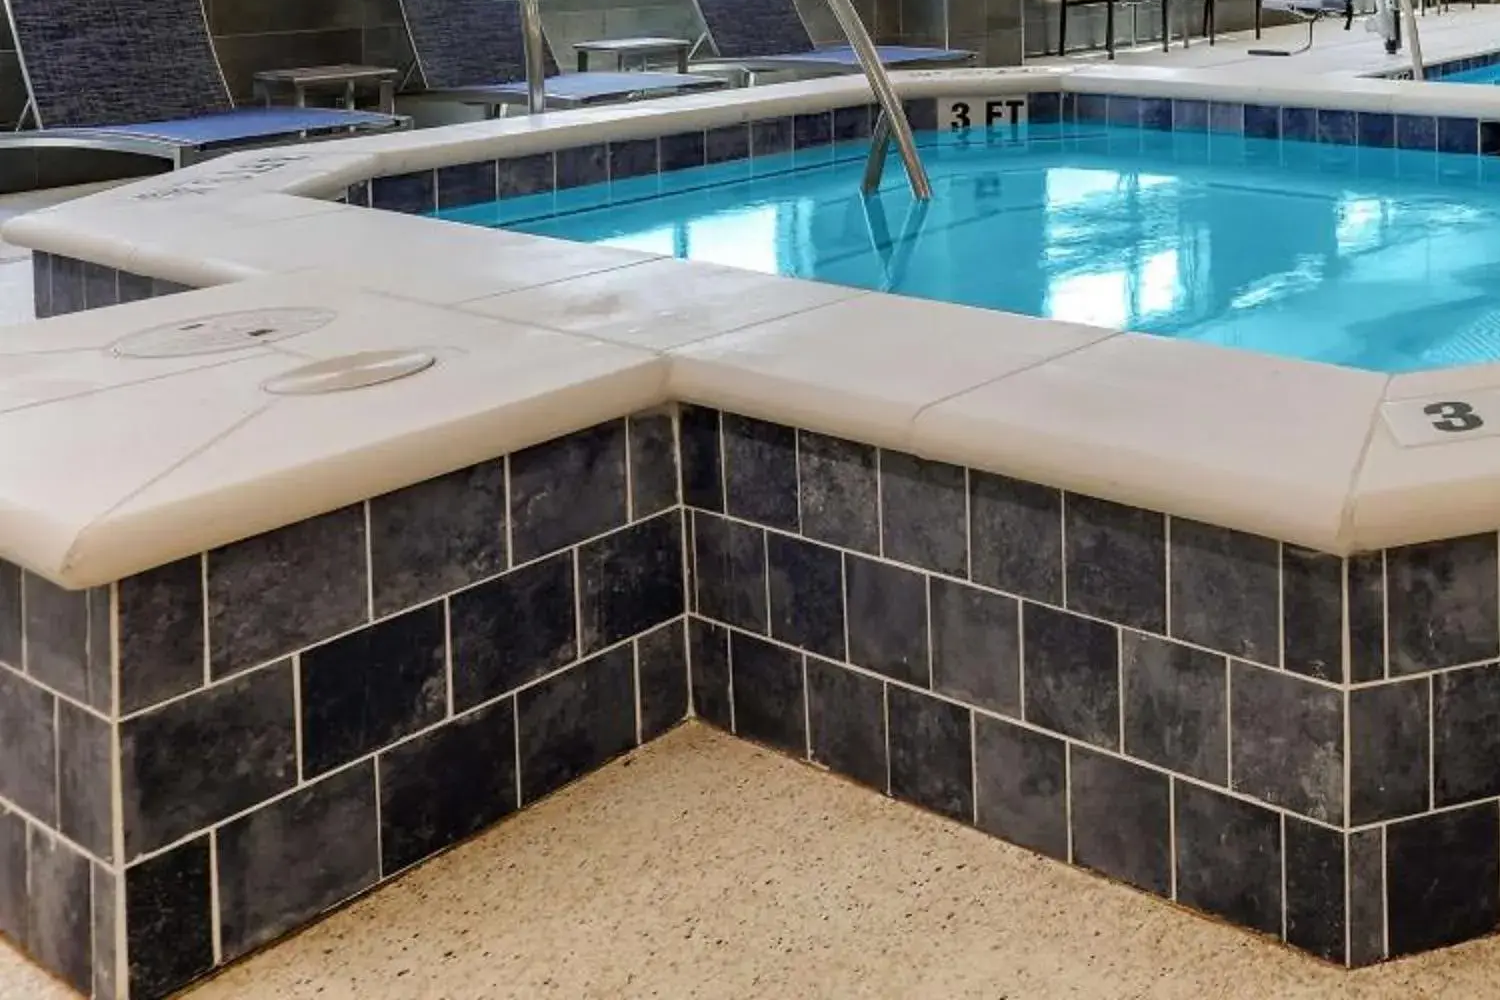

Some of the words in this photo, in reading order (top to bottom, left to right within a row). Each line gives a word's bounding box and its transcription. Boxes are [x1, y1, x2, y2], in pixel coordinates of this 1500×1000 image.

[951, 102, 971, 130] 3
[986, 100, 1025, 126] FT
[1423, 401, 1484, 432] 3
